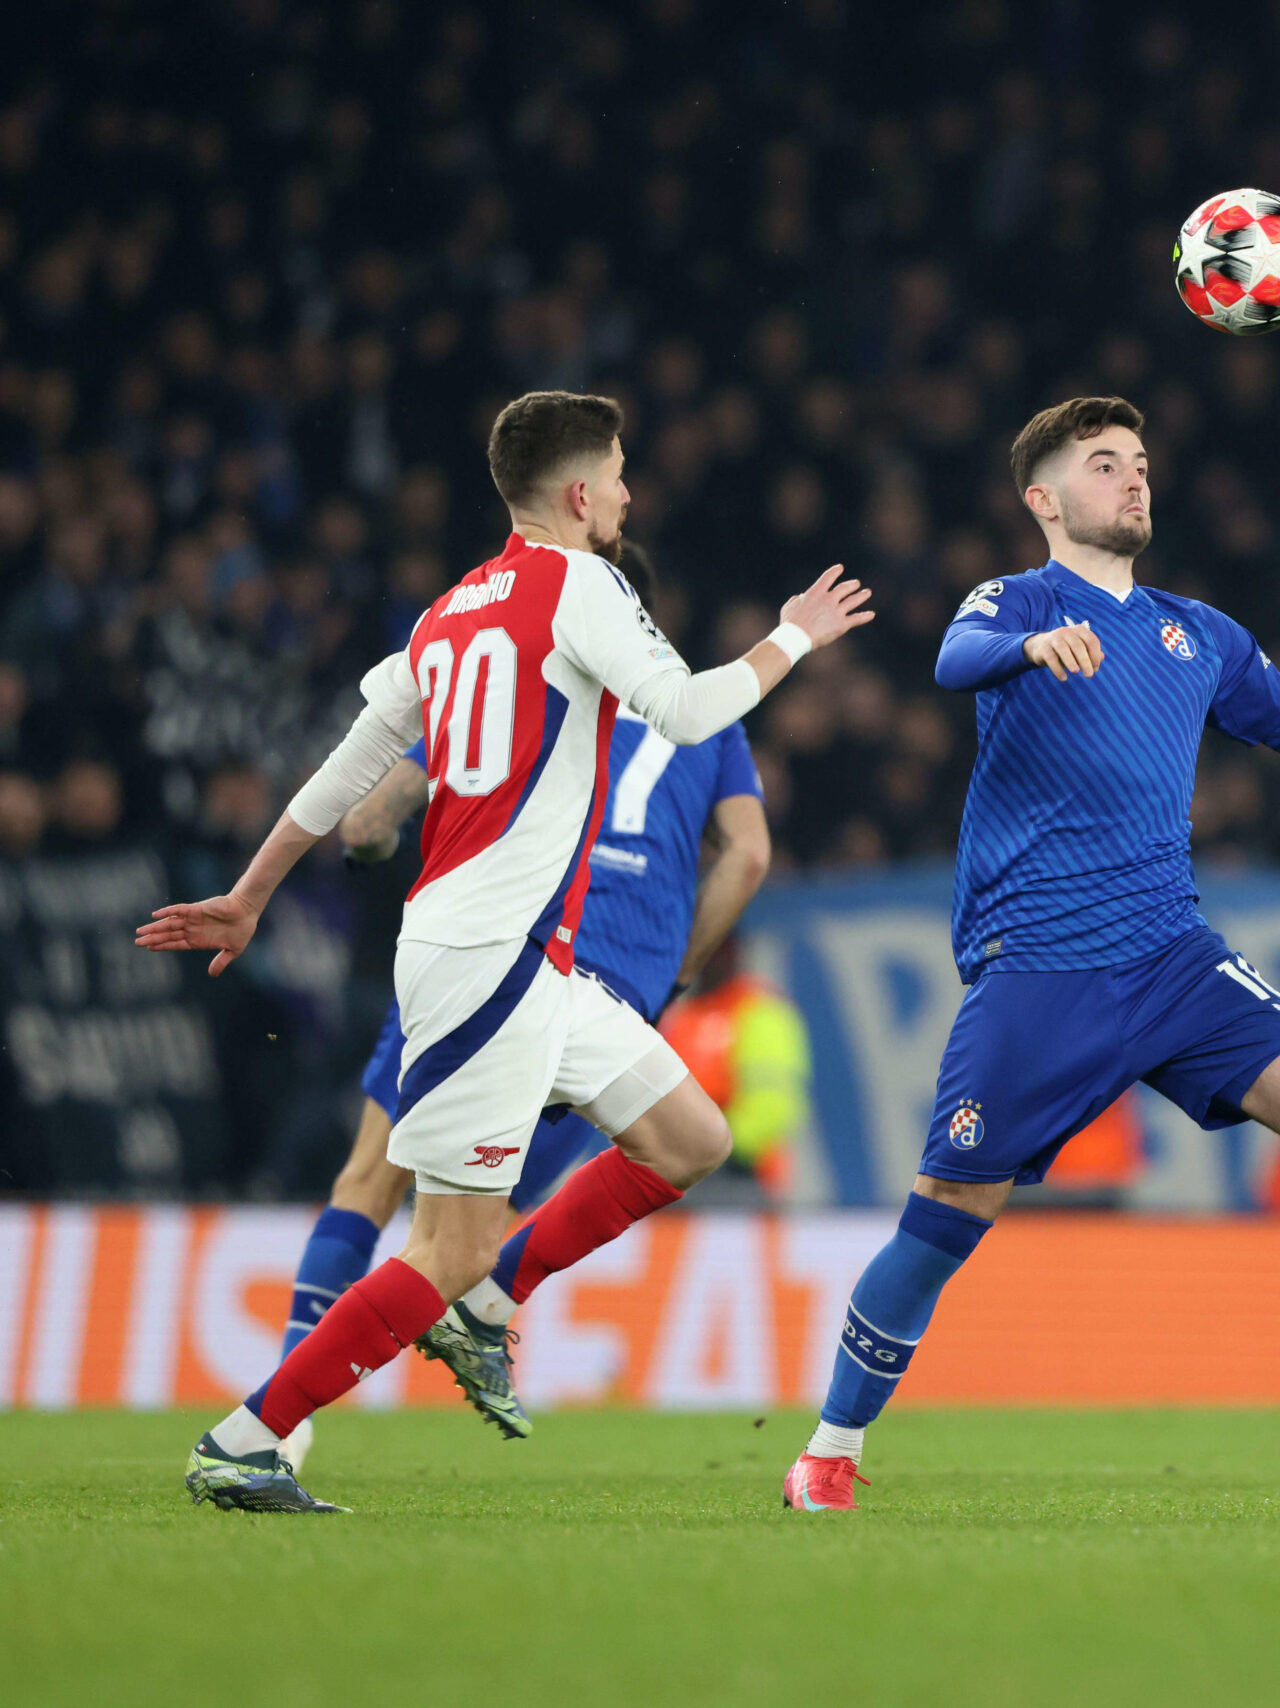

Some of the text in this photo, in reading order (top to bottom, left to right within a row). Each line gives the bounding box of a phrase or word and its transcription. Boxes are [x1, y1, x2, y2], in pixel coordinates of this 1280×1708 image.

[438, 569, 517, 619] JORGHO
[416, 626, 518, 805] 20
[608, 702, 678, 835] 7
